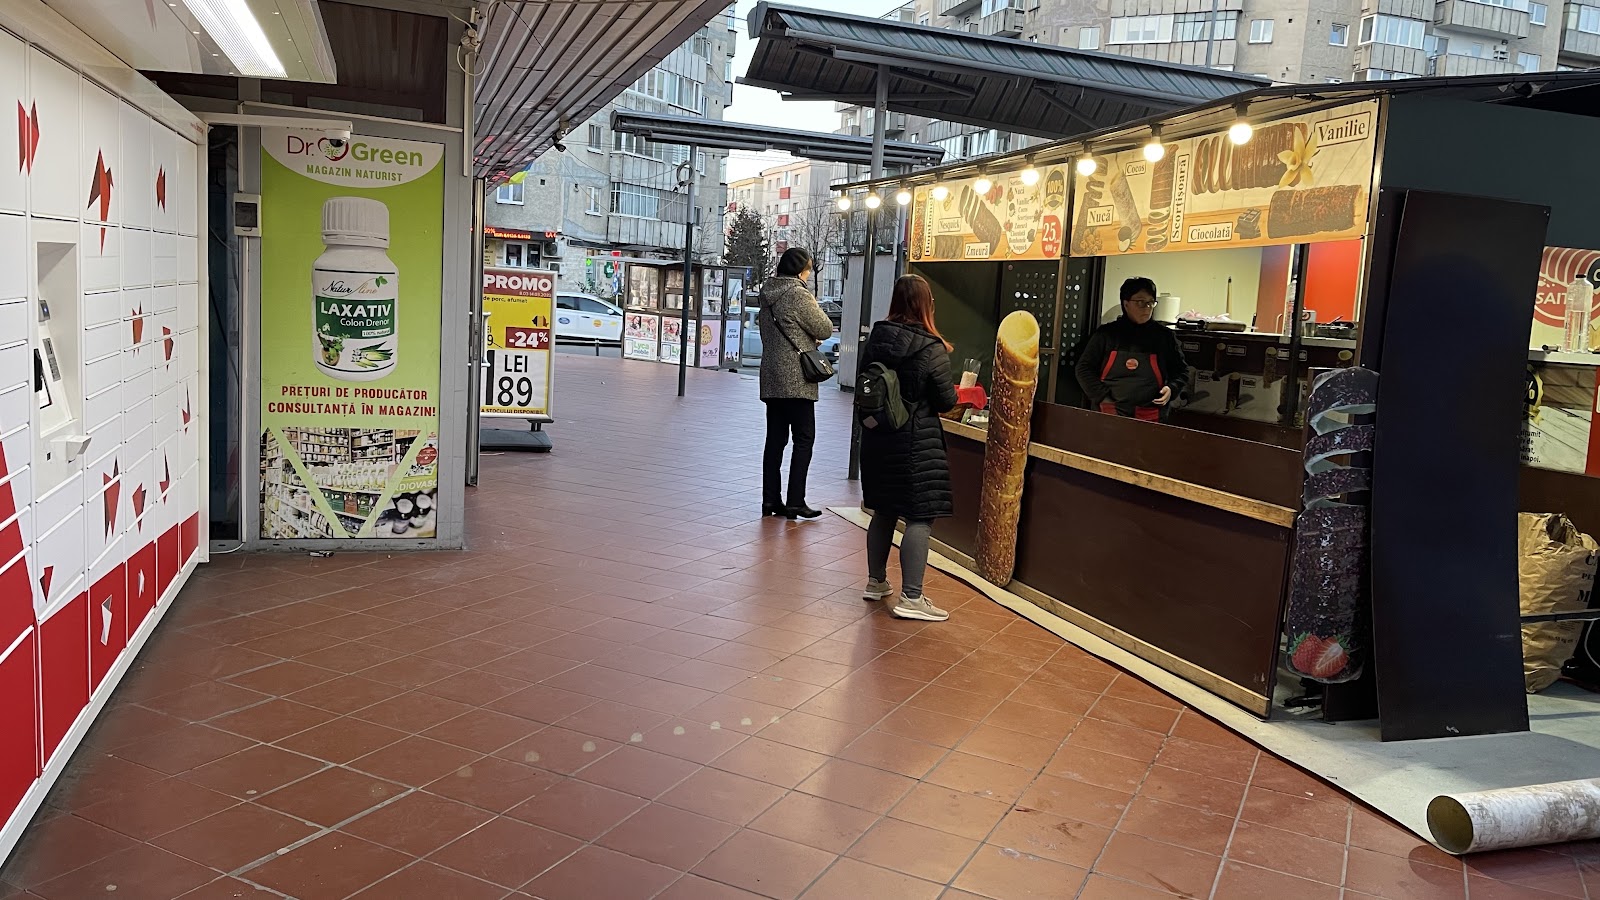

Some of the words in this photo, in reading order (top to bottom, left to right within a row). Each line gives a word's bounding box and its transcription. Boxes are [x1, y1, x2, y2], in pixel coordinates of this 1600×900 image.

[1318, 118, 1367, 142] Vanilie
[287, 135, 314, 156] Dr.
[351, 142, 423, 167] Green
[306, 164, 351, 177] MAGAZIN
[355, 168, 403, 182] NATURIST
[1127, 163, 1146, 175] Cocos
[1047, 180, 1064, 194] 100%
[1172, 157, 1188, 239] Scorțișoară
[1089, 207, 1111, 223] Nucă
[1043, 222, 1057, 242] 25
[1190, 224, 1231, 241] Ciocolată
[966, 245, 990, 257] Zmeură
[484, 274, 552, 292] PROMO
[320, 301, 391, 318] LAXATIV
[340, 318, 365, 327] Colon
[508, 331, 549, 348] -24%
[634, 342, 650, 351] Lyca
[504, 354, 528, 373] LEI
[281, 386, 331, 399] PREȚURI
[336, 387, 349, 398] DE
[354, 387, 427, 400] PRODUCĂTOR
[497, 376, 533, 407] 89
[268, 402, 356, 417] CONSULTANȚĂ
[379, 405, 436, 417] MAGAZIN!
